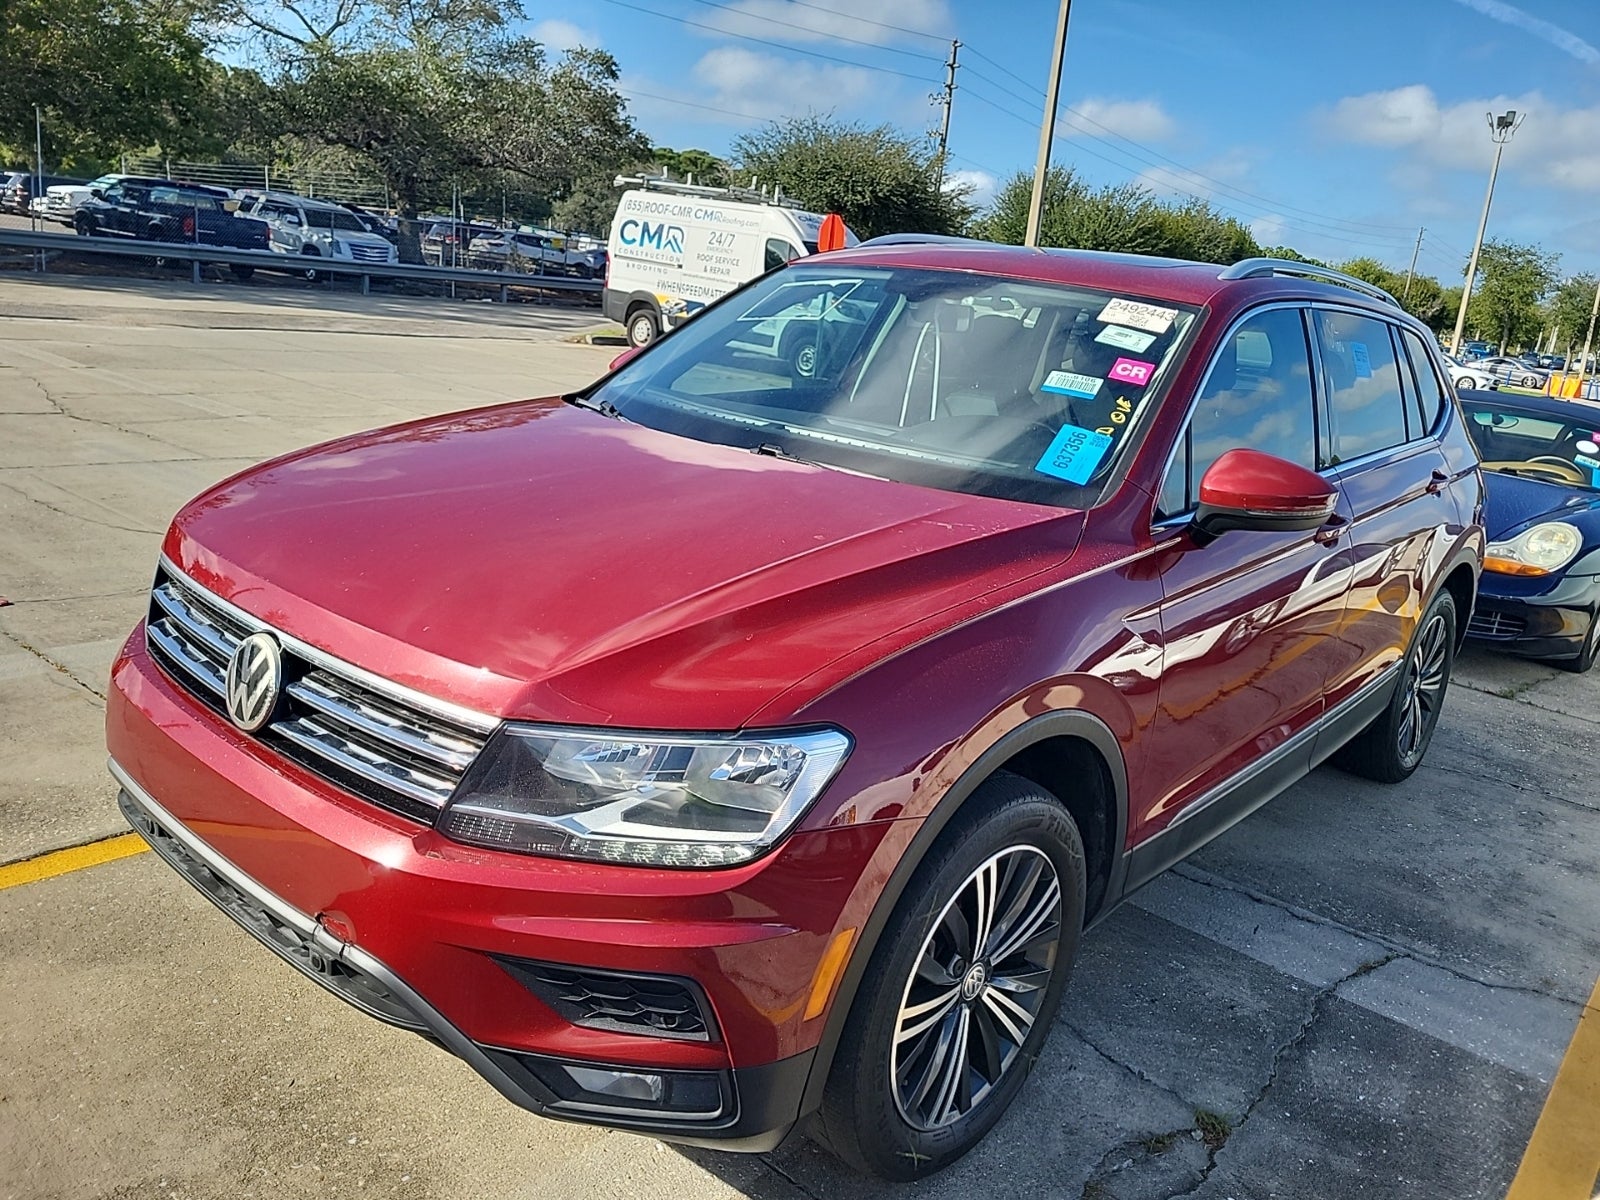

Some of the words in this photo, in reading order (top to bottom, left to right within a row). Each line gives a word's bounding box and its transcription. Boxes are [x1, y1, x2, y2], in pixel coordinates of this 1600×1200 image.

[619, 219, 684, 254] CMR
[708, 231, 736, 248] 24/7
[618, 247, 681, 263] CONSTRUCTION
[696, 253, 714, 263] ROOF
[714, 255, 741, 267] SERVICE
[709, 266, 732, 276] REPAIR
[1110, 301, 1177, 322] 2492443
[1115, 363, 1148, 381] CR
[1052, 431, 1088, 470] 637356
